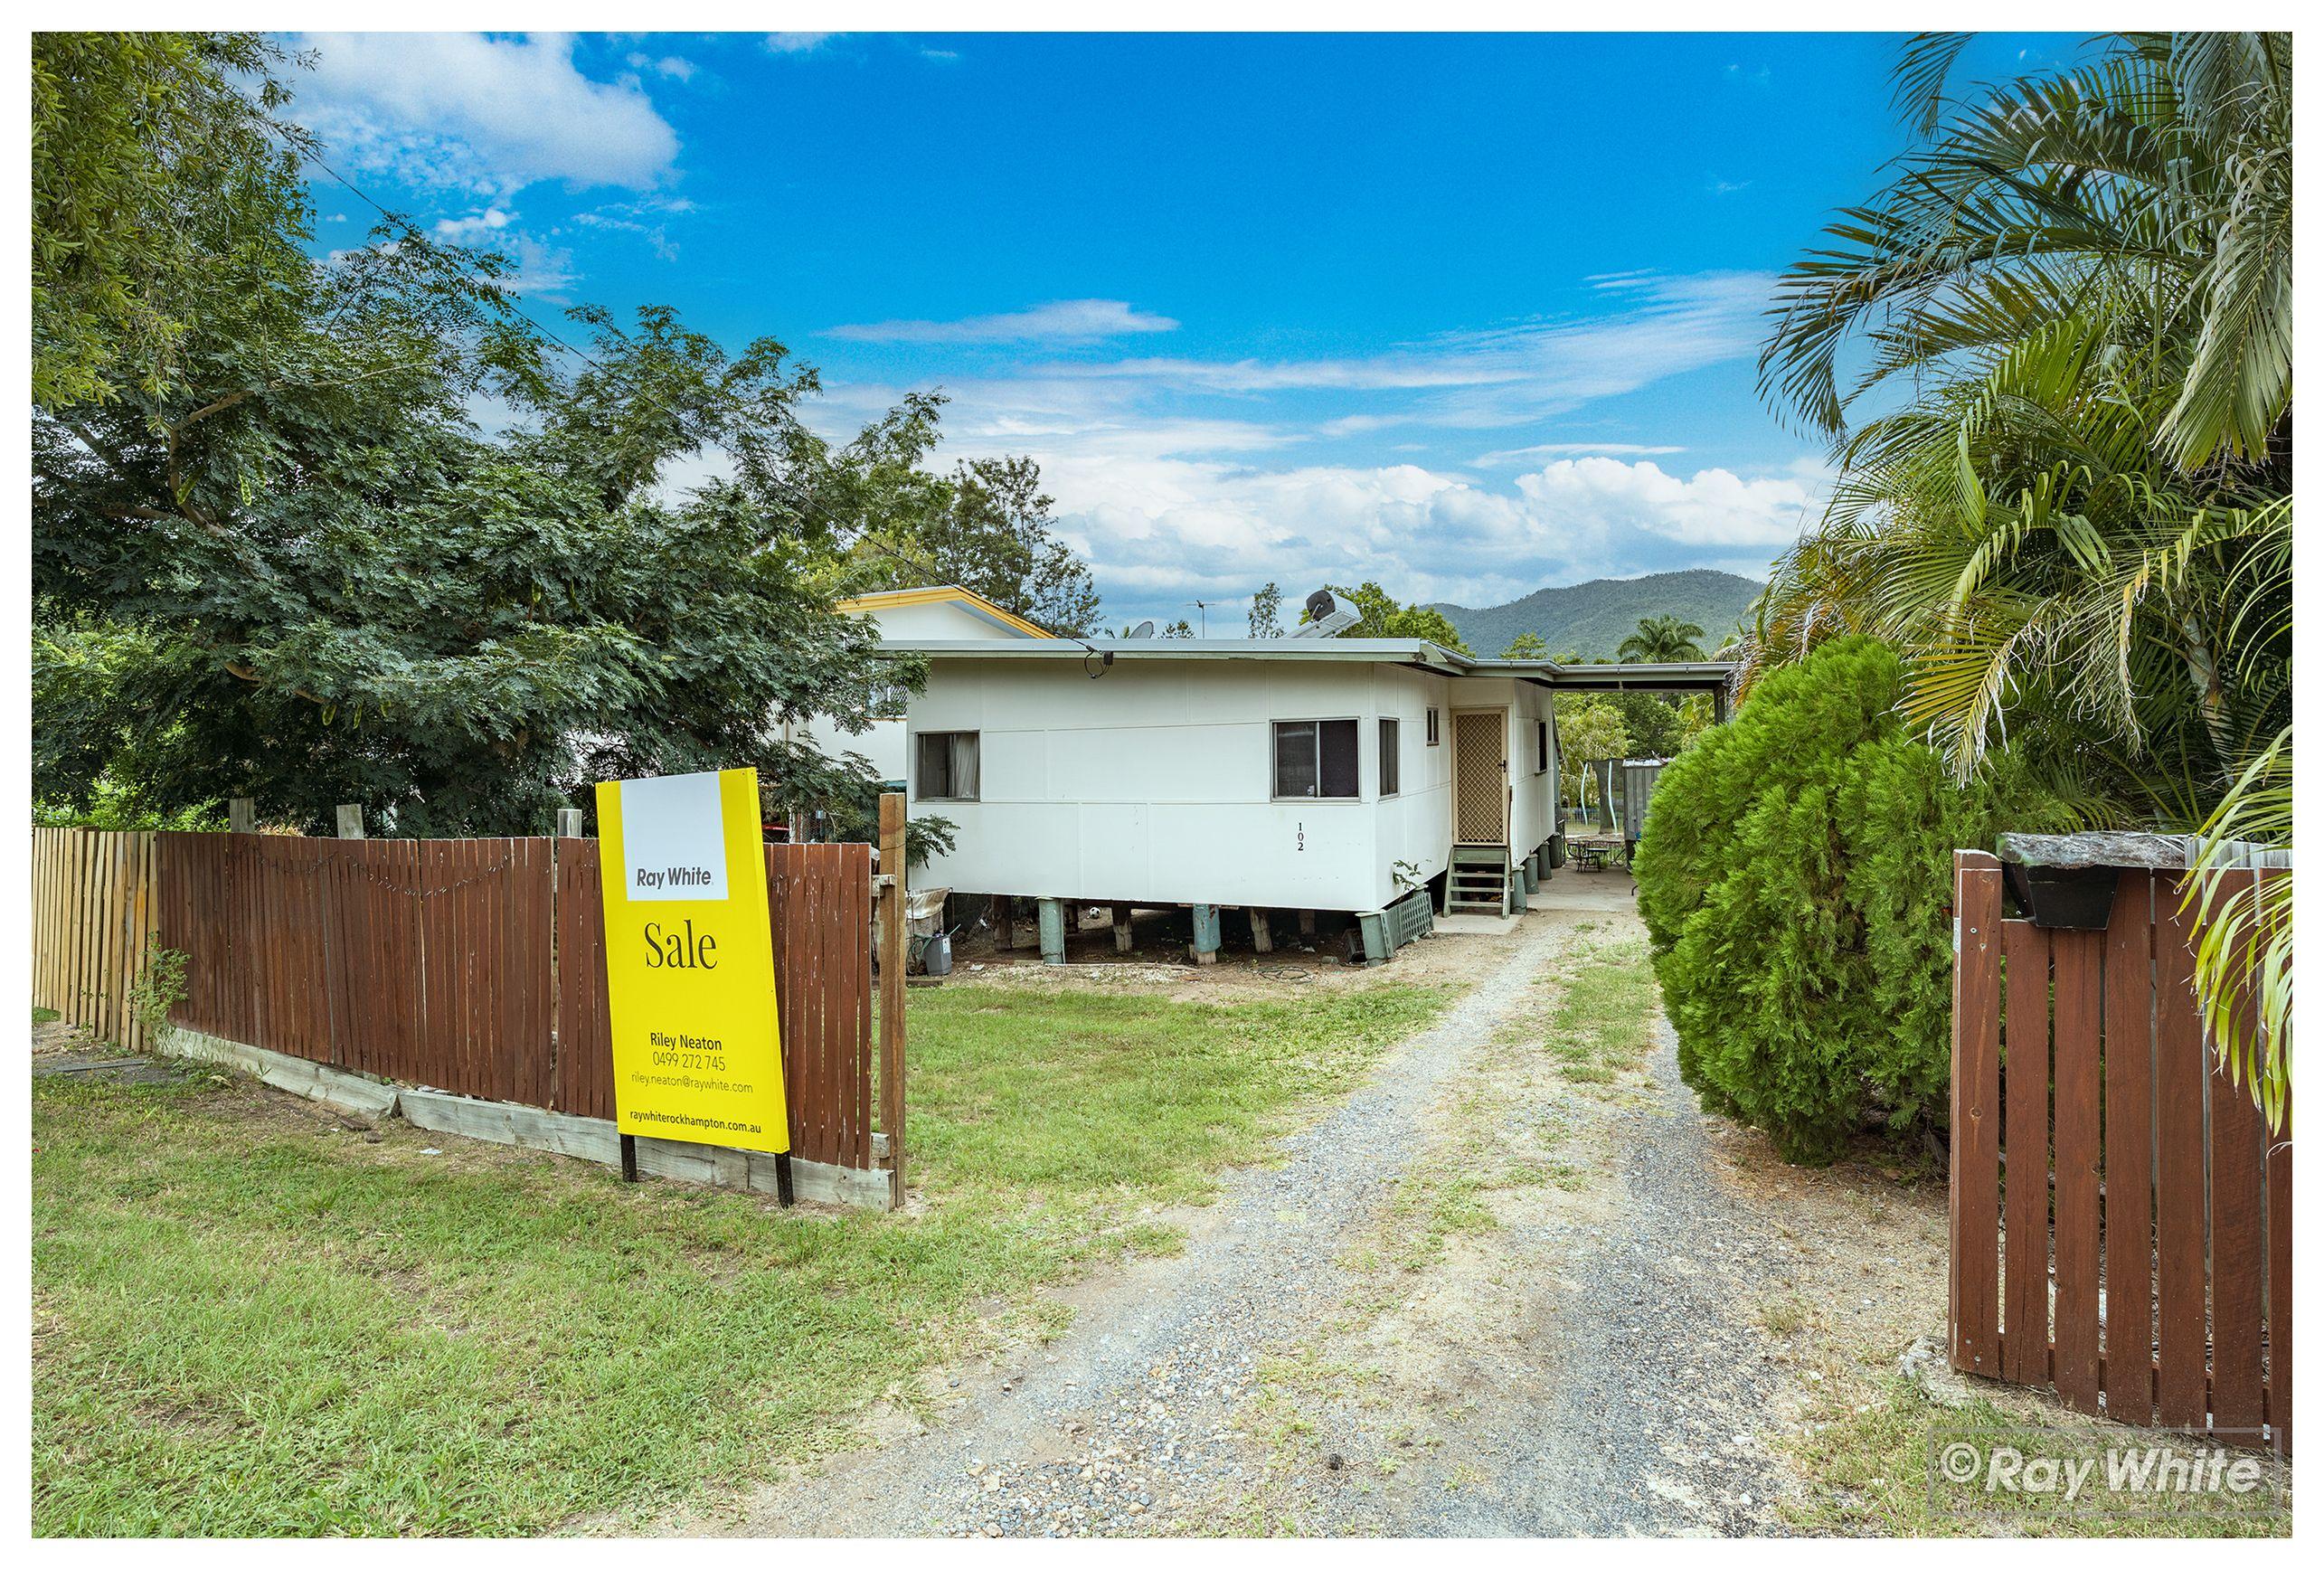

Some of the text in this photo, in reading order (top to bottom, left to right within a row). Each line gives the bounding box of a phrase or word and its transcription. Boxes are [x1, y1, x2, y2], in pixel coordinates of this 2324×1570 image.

[637, 866, 712, 890] Ray White
[644, 919, 718, 969] Sale
[650, 1032, 723, 1051] Riley Neaton
[652, 1051, 726, 1072] 0499 272 745
[631, 1071, 753, 1093] riley.neaton@raywhite.com
[629, 1110, 761, 1134] raywhiterockhampton.com.au
